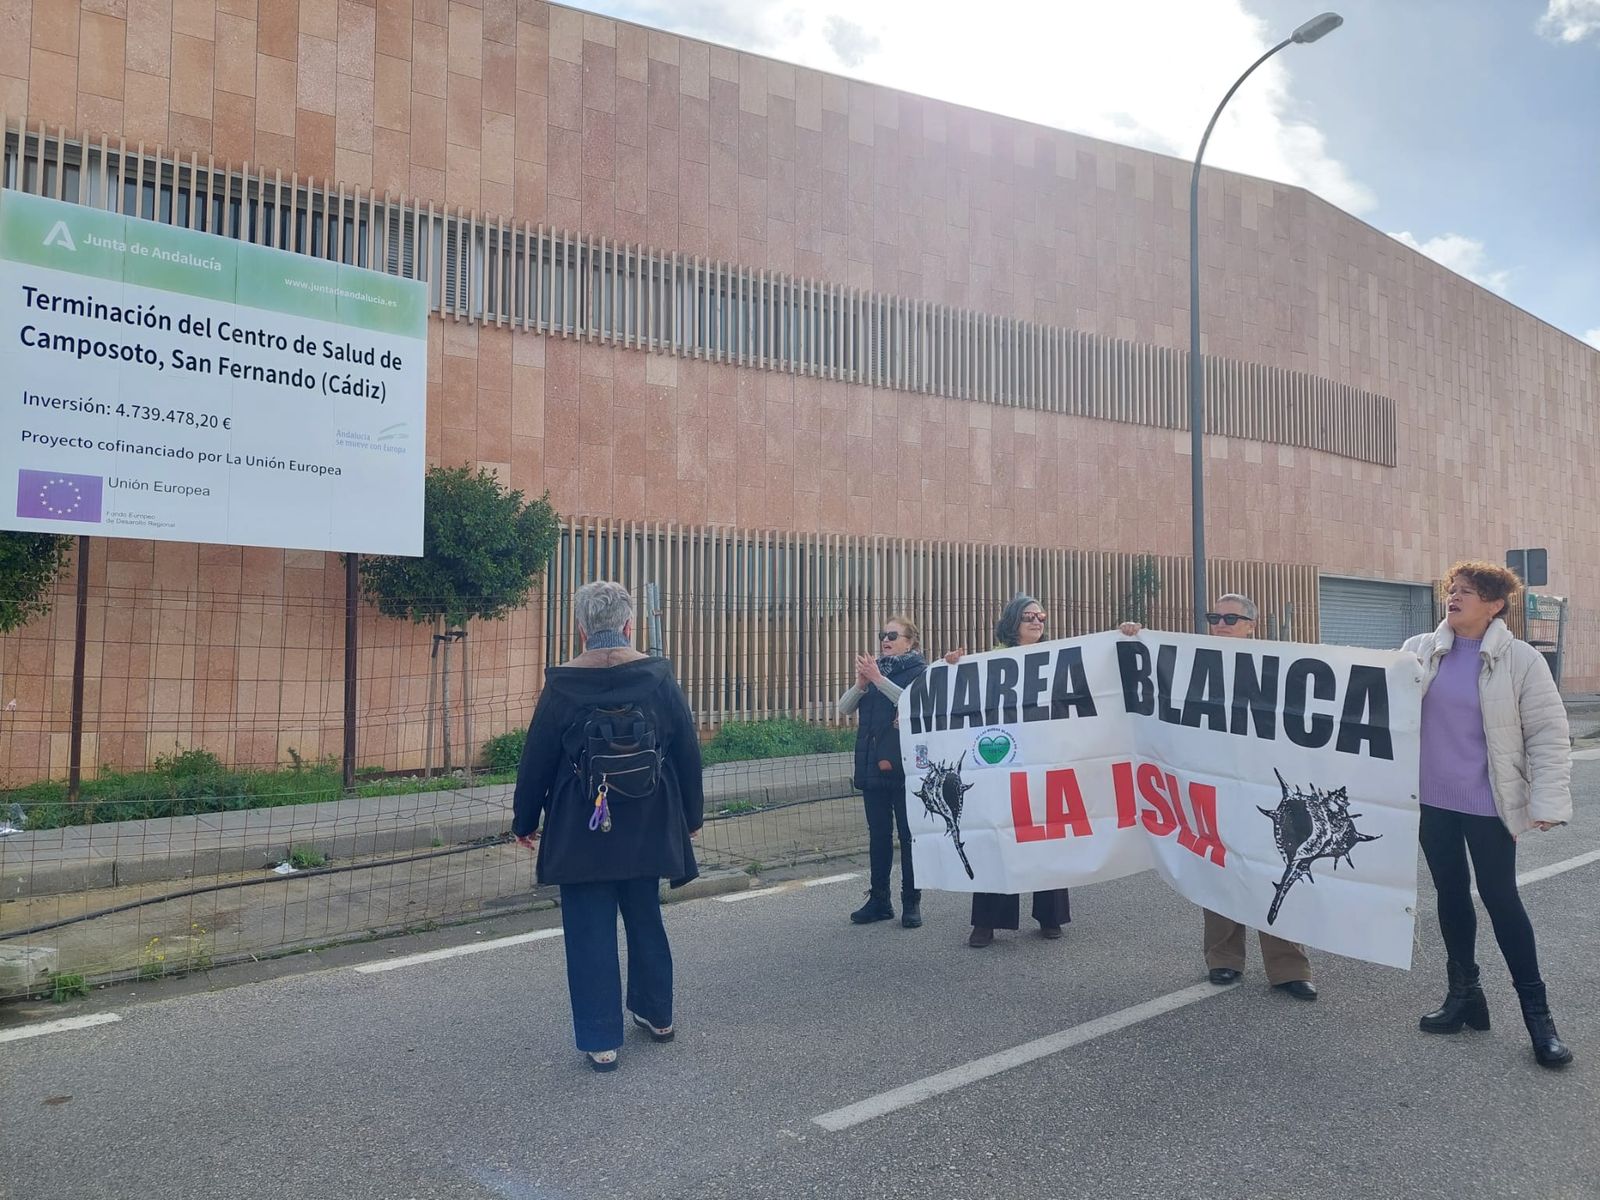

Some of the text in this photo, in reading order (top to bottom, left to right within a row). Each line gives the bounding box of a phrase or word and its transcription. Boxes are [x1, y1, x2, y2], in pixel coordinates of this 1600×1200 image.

[83, 232, 222, 272] Junta de Andalucía
[22, 285, 402, 370] Terminación del Centro de Salud de
[20, 325, 387, 404] Camposoto, San Fernando (Cádiz)
[22, 390, 231, 430] Inversión: 4.739.478,20 €
[21, 430, 342, 477] Proyecto cofinanciado por La Unión Europea
[108, 476, 211, 498] Unión Europea
[909, 641, 1395, 760] MAREA BLANCA
[1010, 761, 1226, 868] LA ISLA
